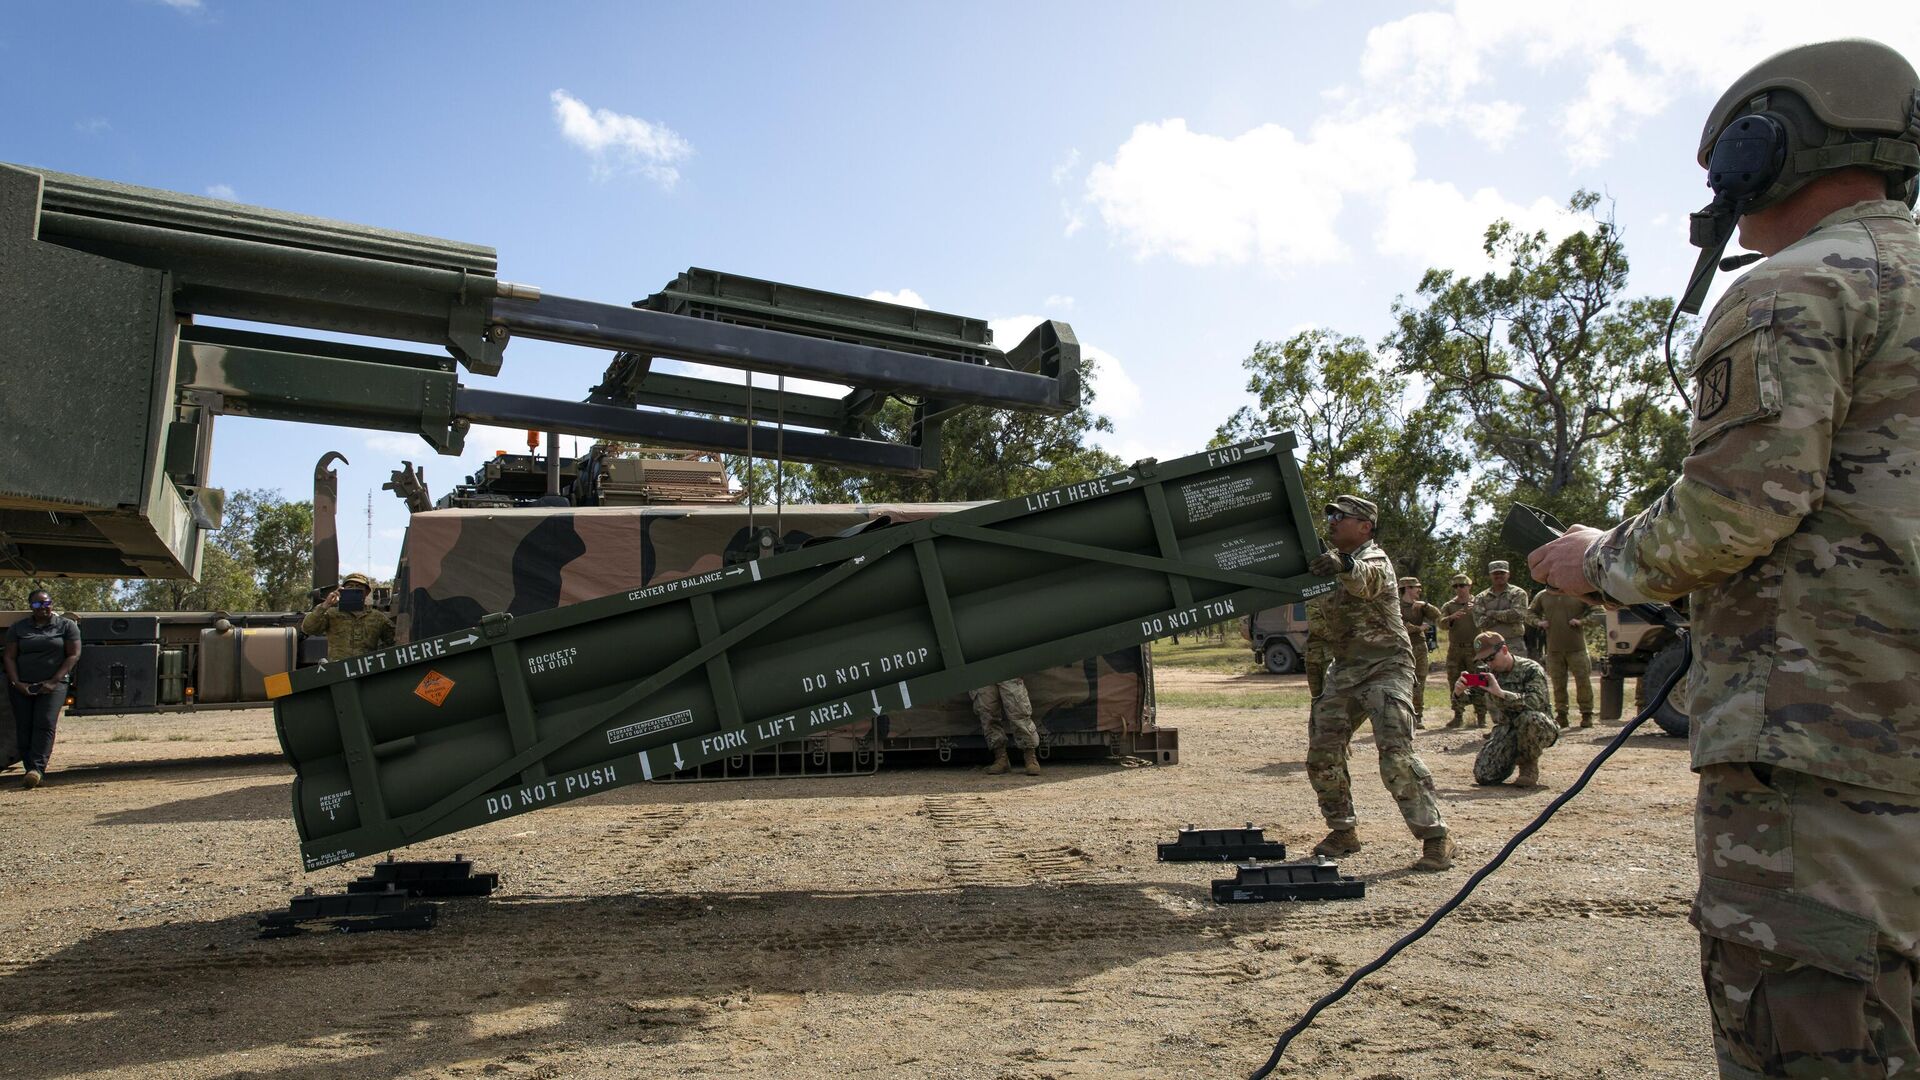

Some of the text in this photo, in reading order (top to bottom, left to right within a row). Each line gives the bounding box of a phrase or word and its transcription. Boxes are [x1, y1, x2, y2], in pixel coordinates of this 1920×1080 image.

[1207, 447, 1241, 467] FWD
[1026, 479, 1109, 511] LIFT HERE
[628, 571, 723, 601] CENTER OF BALANCE
[1141, 599, 1235, 636] DO NOT TOW
[344, 638, 446, 678] LIFT HERE
[528, 647, 577, 666] ROCKETS
[530, 656, 573, 674] UN 0181
[802, 647, 927, 692] DO NOT DROP
[609, 712, 689, 737] STORAGE TEMPERATURE LIMITS
[701, 701, 853, 755] FORK LIFT AREA
[319, 790, 352, 802] PRESSURE
[320, 797, 341, 807] RELIEF
[487, 766, 616, 815] DO NOT PUSH
[321, 802, 341, 812] VALVE
